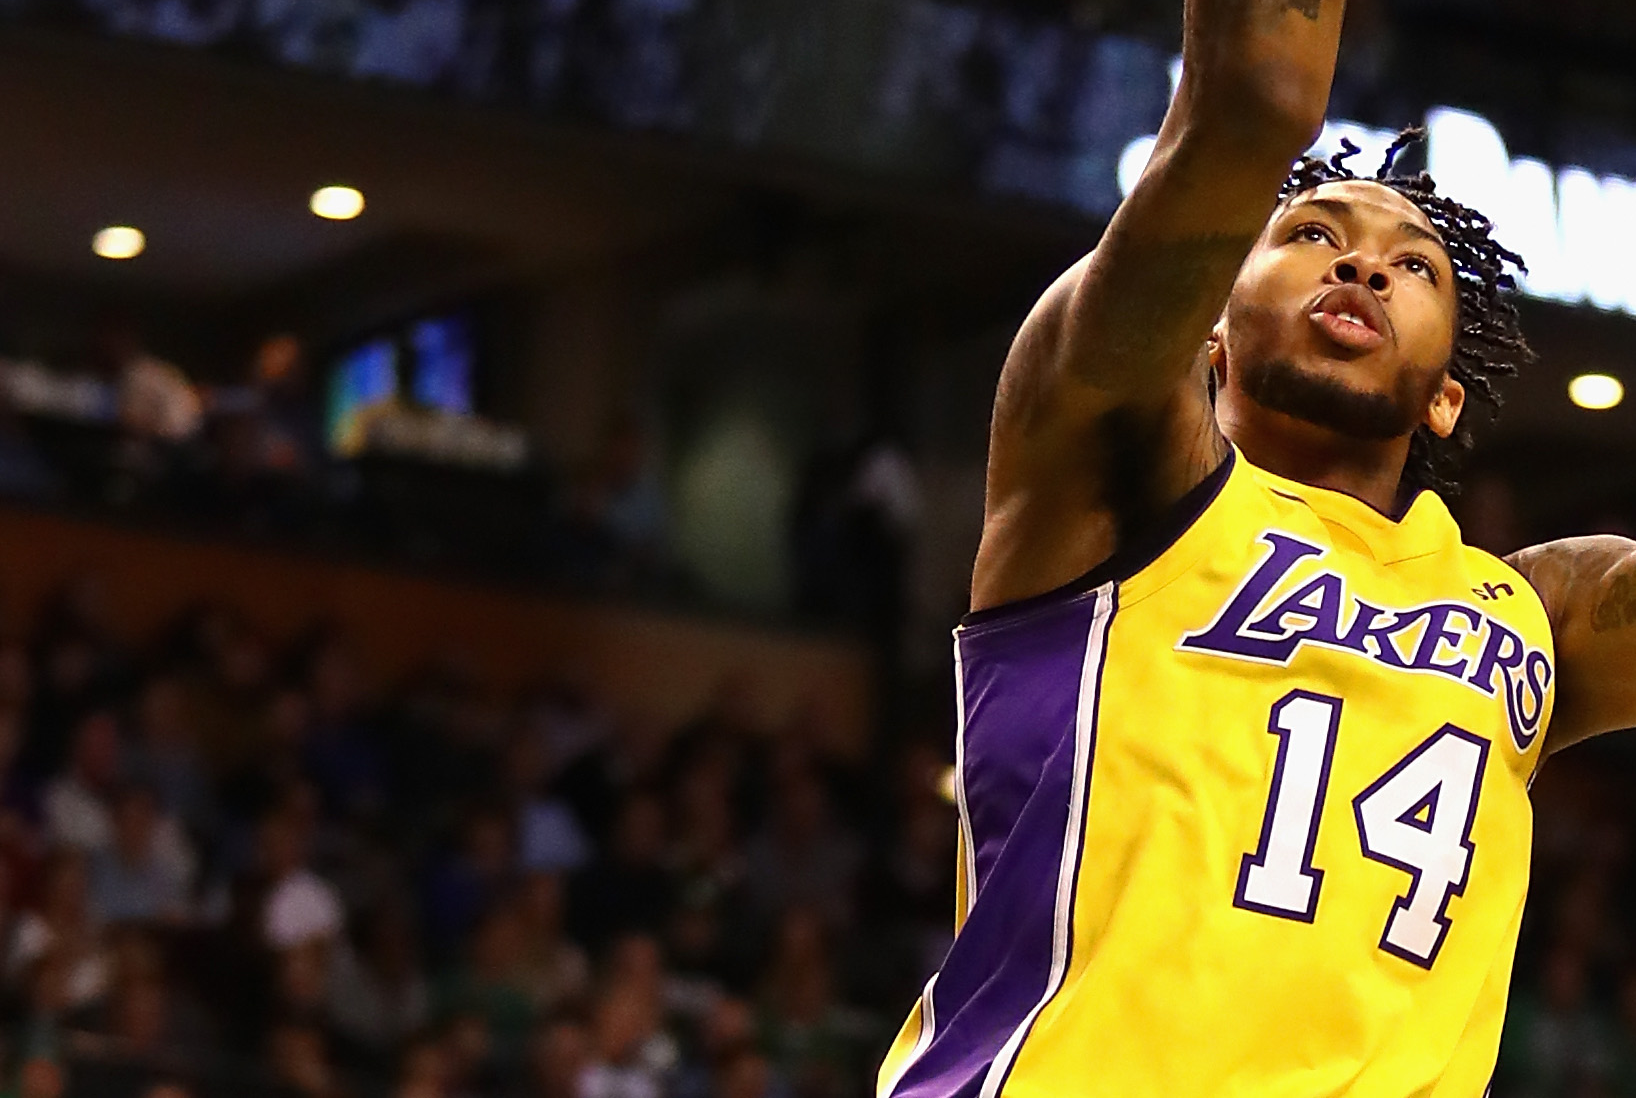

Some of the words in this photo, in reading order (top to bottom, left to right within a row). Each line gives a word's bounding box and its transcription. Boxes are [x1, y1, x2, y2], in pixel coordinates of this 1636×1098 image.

[1173, 528, 1554, 755] LAKERS
[1471, 582, 1515, 601] sh
[1232, 687, 1491, 971] 14
